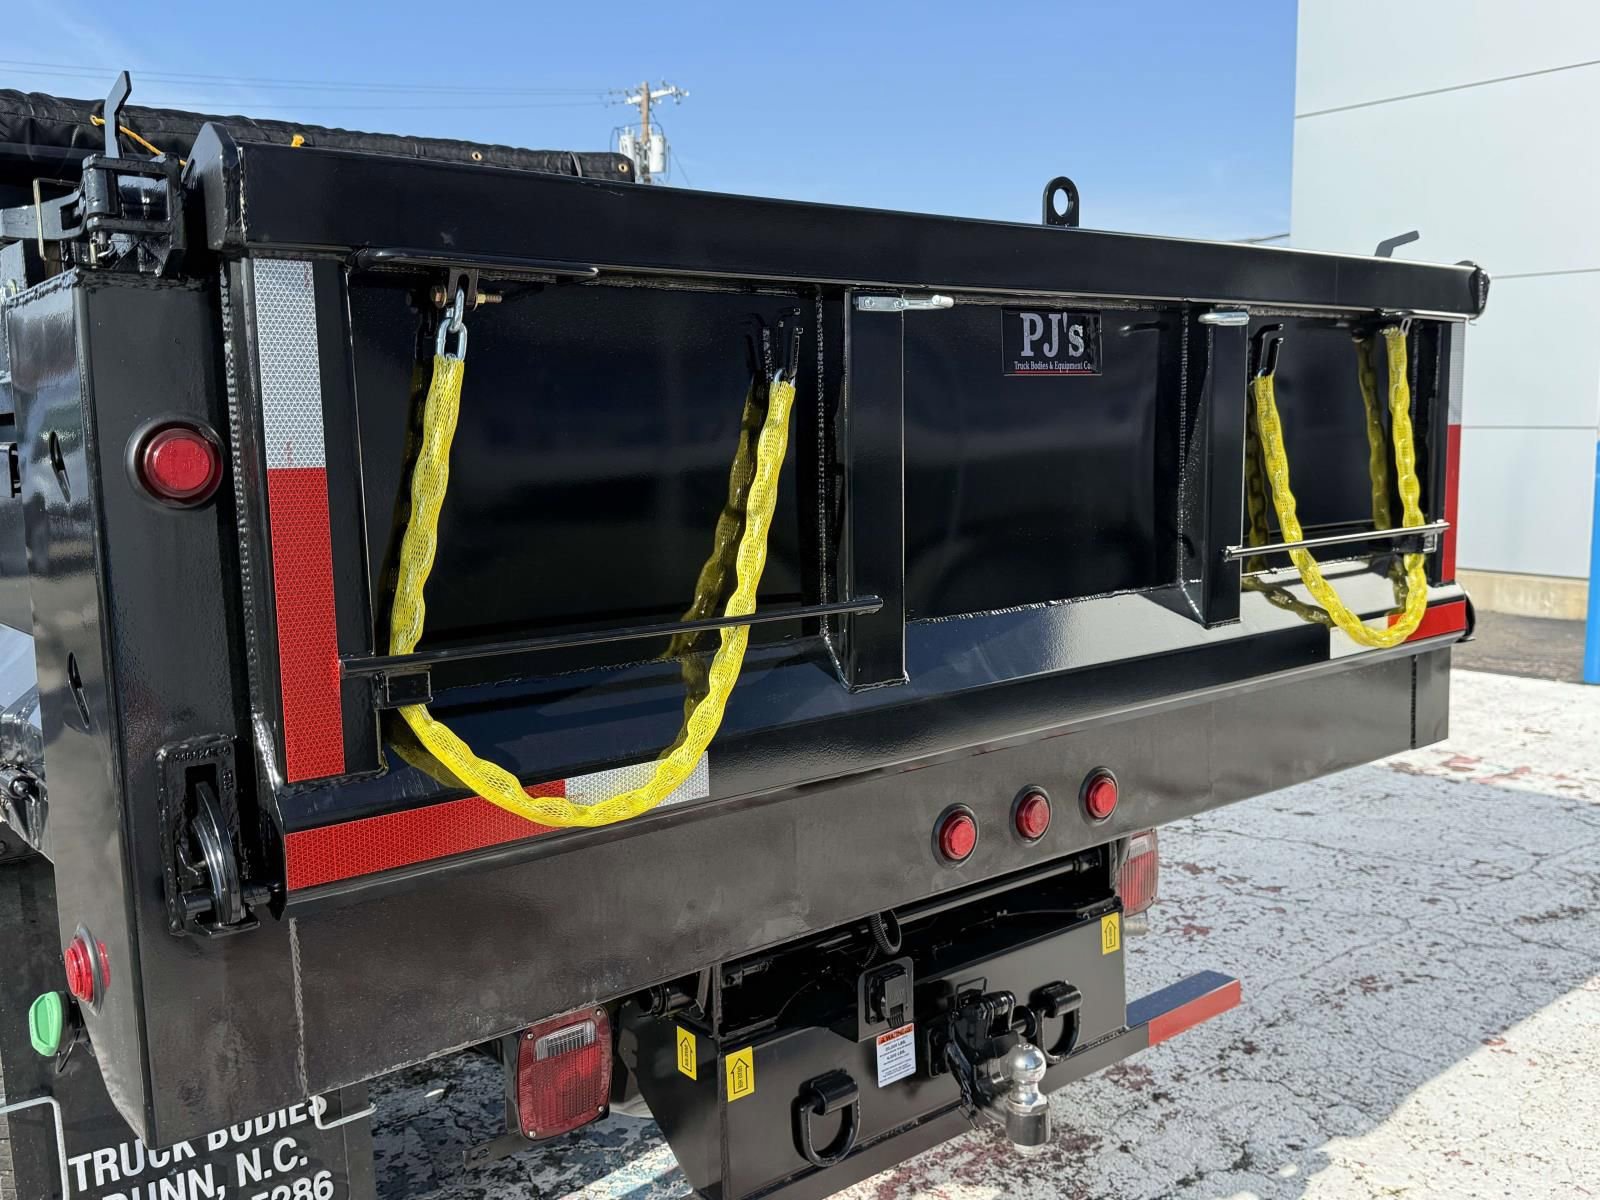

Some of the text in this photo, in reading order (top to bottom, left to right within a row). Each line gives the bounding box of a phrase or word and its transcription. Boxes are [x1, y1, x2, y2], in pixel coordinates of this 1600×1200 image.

[1020, 312, 1084, 357] PJ's
[1014, 361, 1030, 370] Truck
[1031, 361, 1048, 370] Bodies
[1054, 361, 1083, 373] Equipment
[236, 1137, 308, 1188] N.C.
